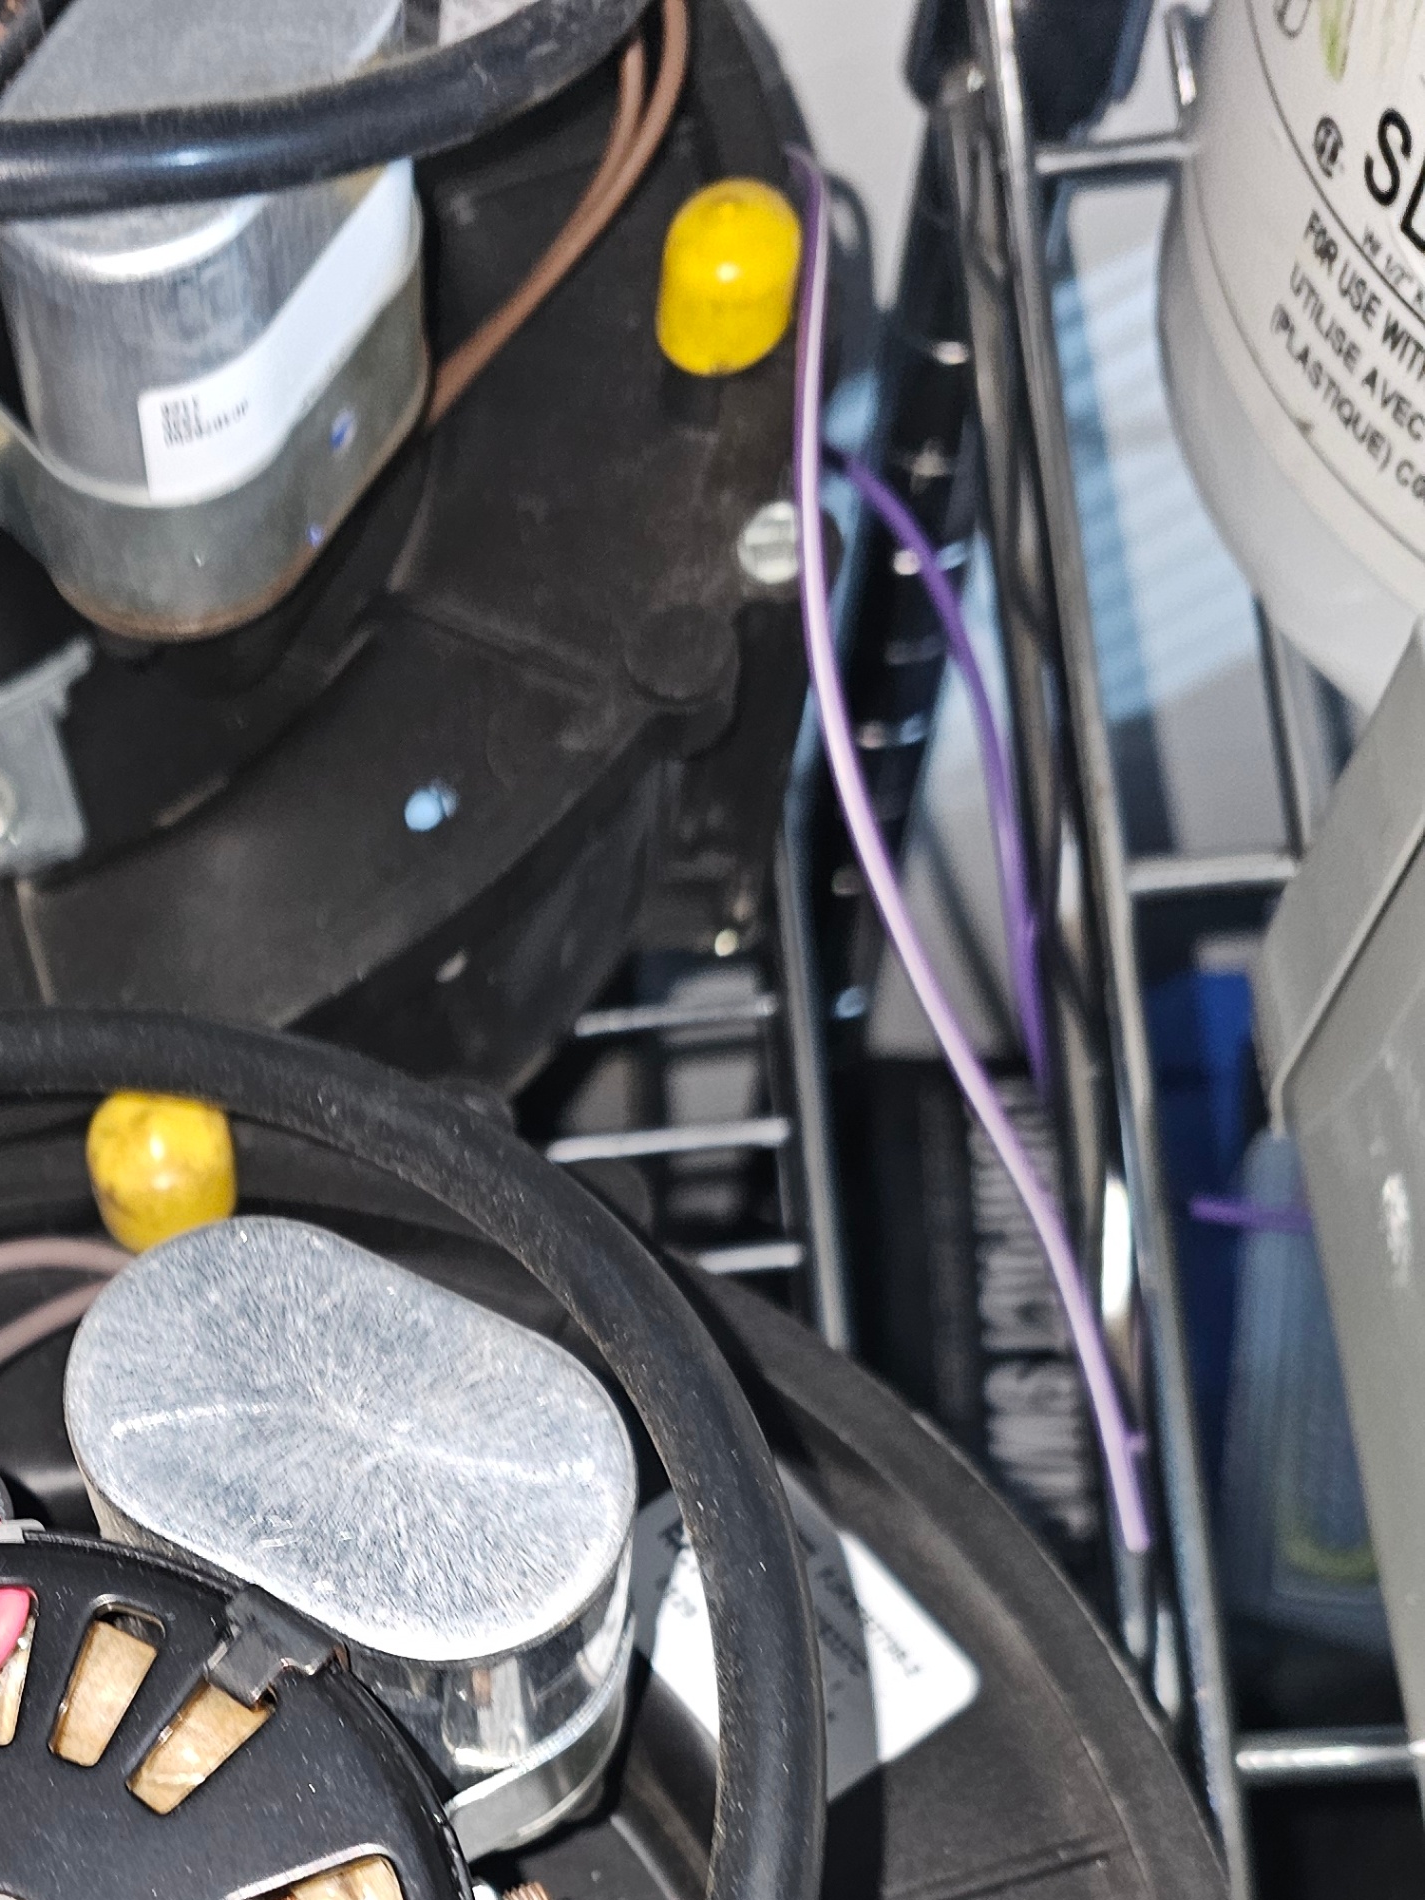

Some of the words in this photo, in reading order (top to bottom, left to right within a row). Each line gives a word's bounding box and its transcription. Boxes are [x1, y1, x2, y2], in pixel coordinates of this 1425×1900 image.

[1290, 258, 1362, 374] UTILISE
[1362, 366, 1425, 441] AVEC
[1338, 259, 1382, 330] USE
